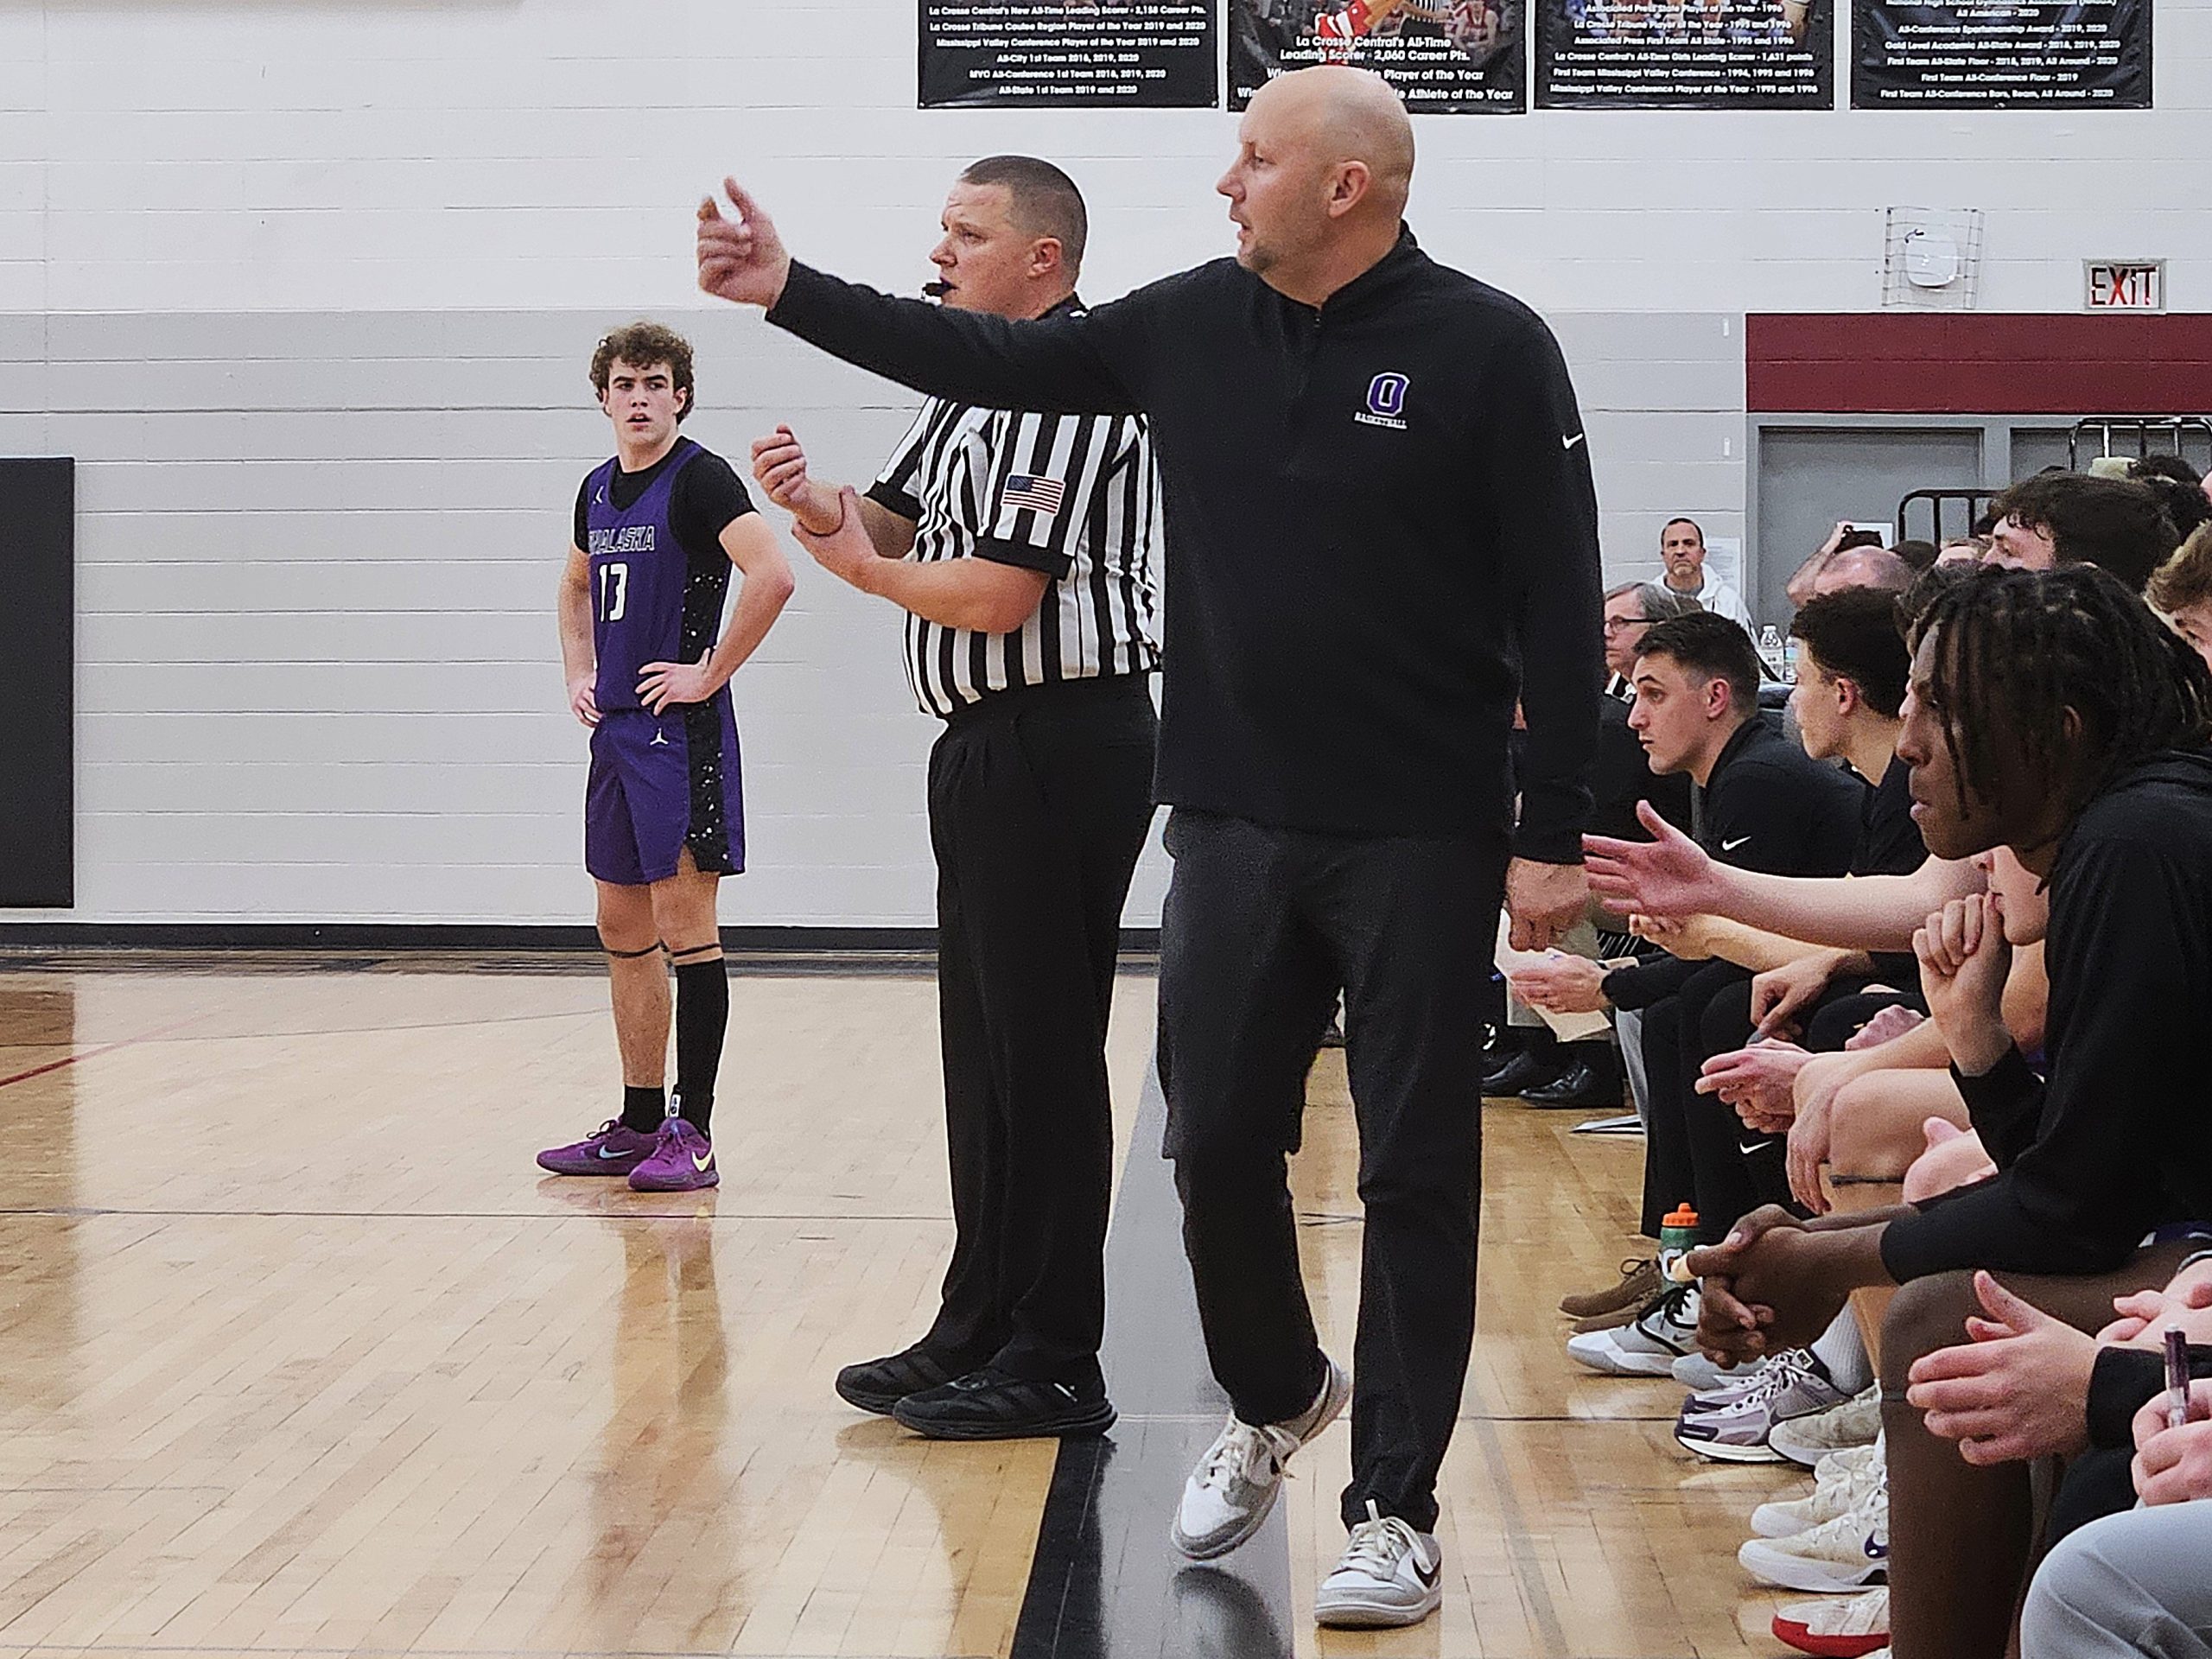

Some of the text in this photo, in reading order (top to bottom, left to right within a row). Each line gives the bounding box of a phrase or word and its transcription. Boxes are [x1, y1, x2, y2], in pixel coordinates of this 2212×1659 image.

[1296, 35, 1451, 48] La Crosse Central's All-Time
[1281, 49, 1470, 62] Leading Scorer 2,060 Career Pts.
[1384, 70, 1420, 82] Player
[1421, 69, 1433, 79] of
[1436, 70, 1454, 80] the
[1458, 70, 1484, 80] Year
[1408, 88, 1448, 99] Athlete
[1451, 89, 1463, 99] of
[1465, 89, 1484, 99] the
[1486, 89, 1513, 99] Year
[2090, 266, 2157, 306] EXIT
[599, 563, 628, 622] 13
